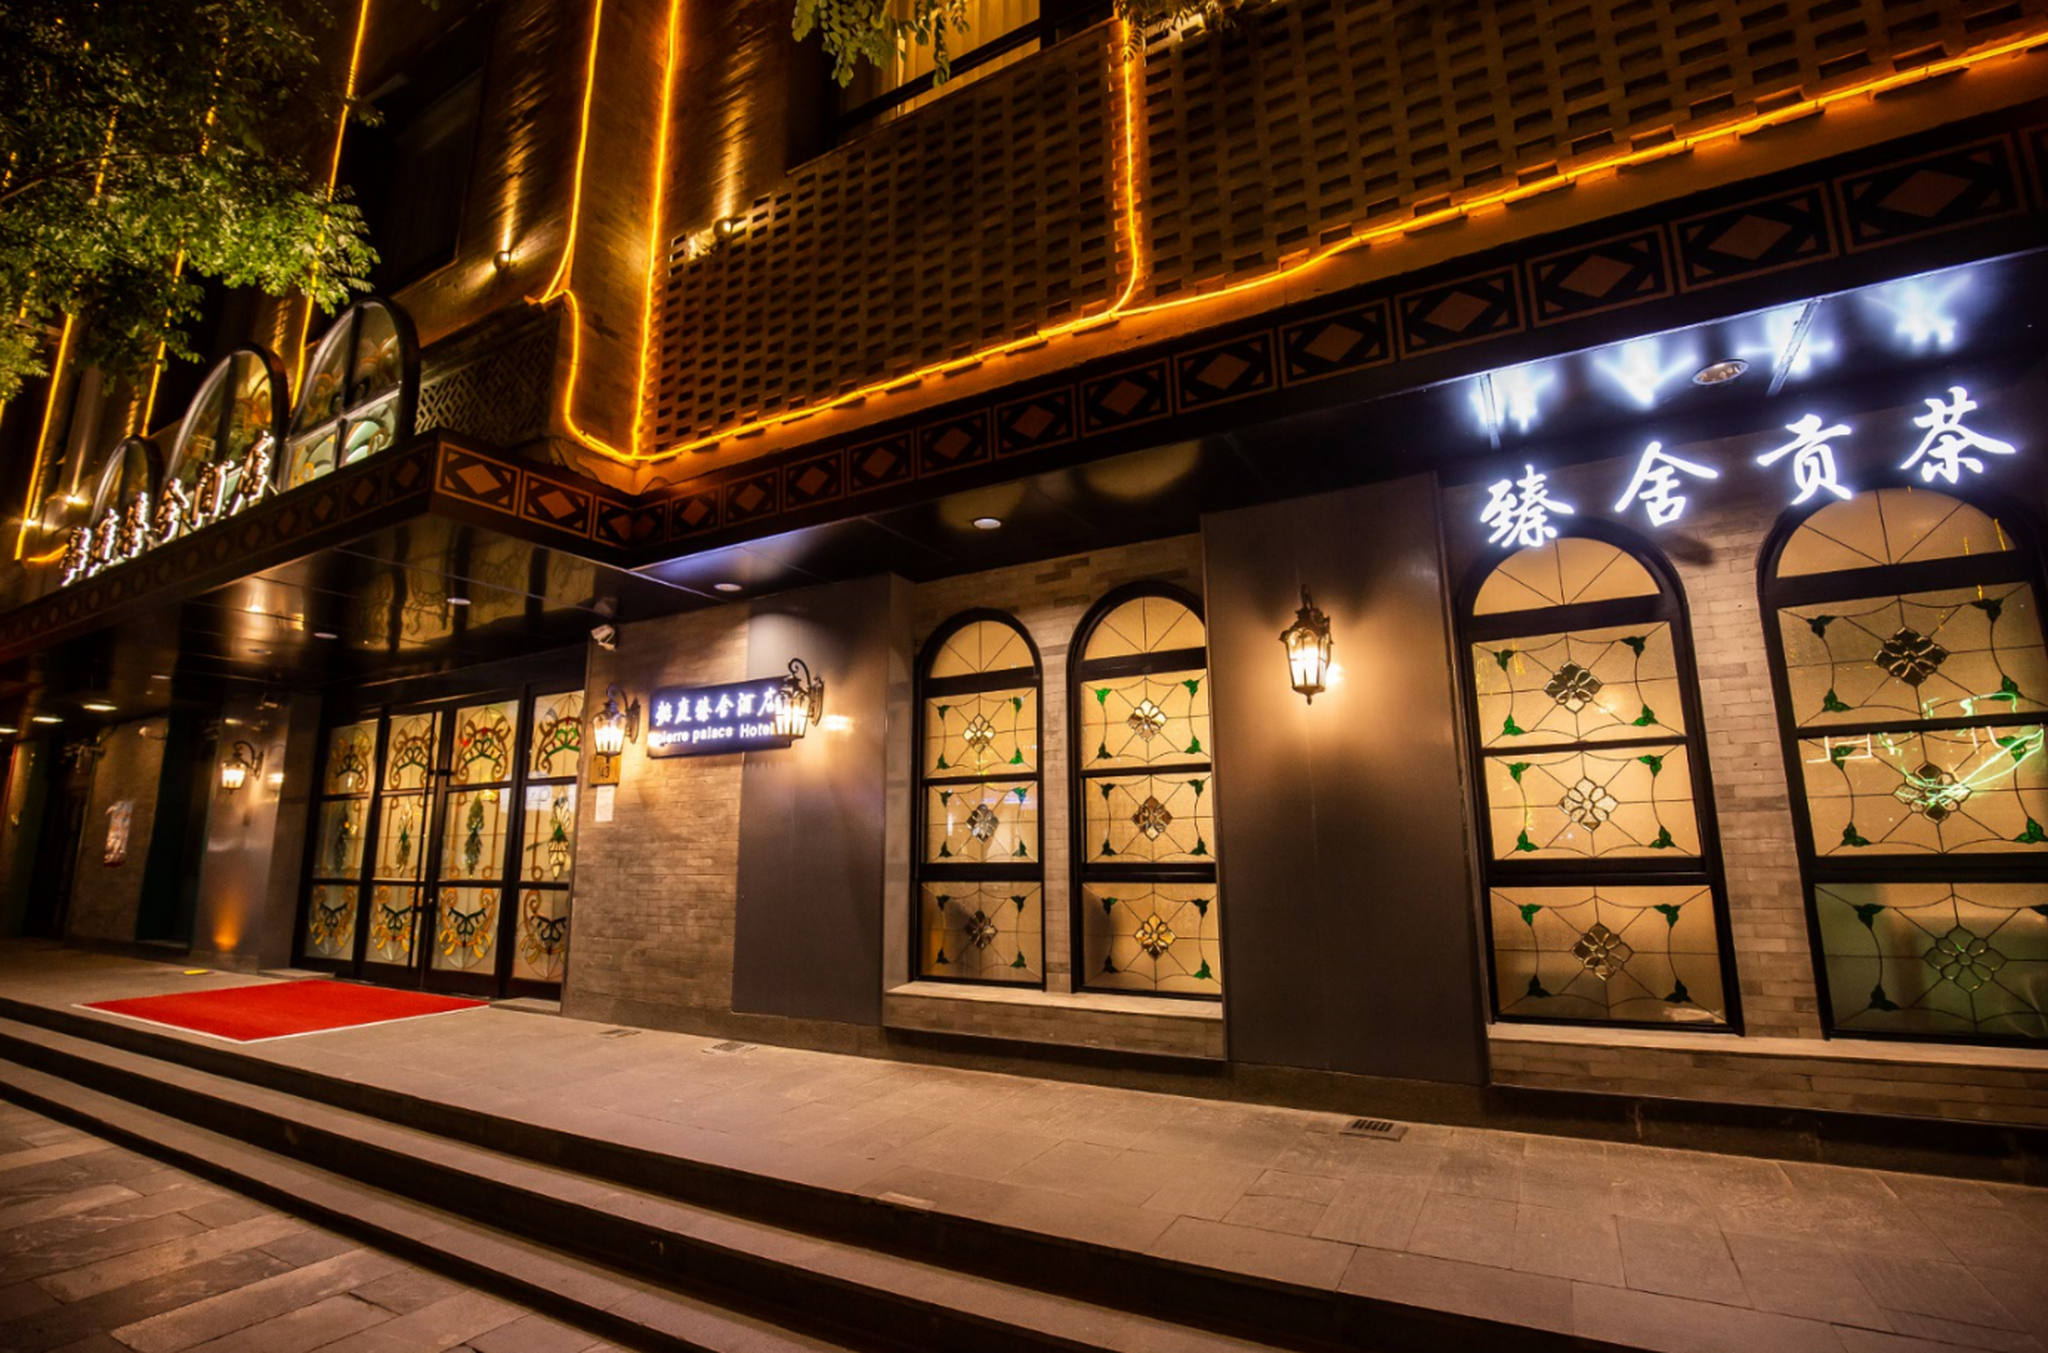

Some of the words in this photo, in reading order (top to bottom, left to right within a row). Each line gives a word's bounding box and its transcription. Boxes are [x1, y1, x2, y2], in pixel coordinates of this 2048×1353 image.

[1479, 386, 2017, 549] 臻舍贡茶
[693, 726, 733, 743] palace
[739, 722, 774, 738] Hotel
